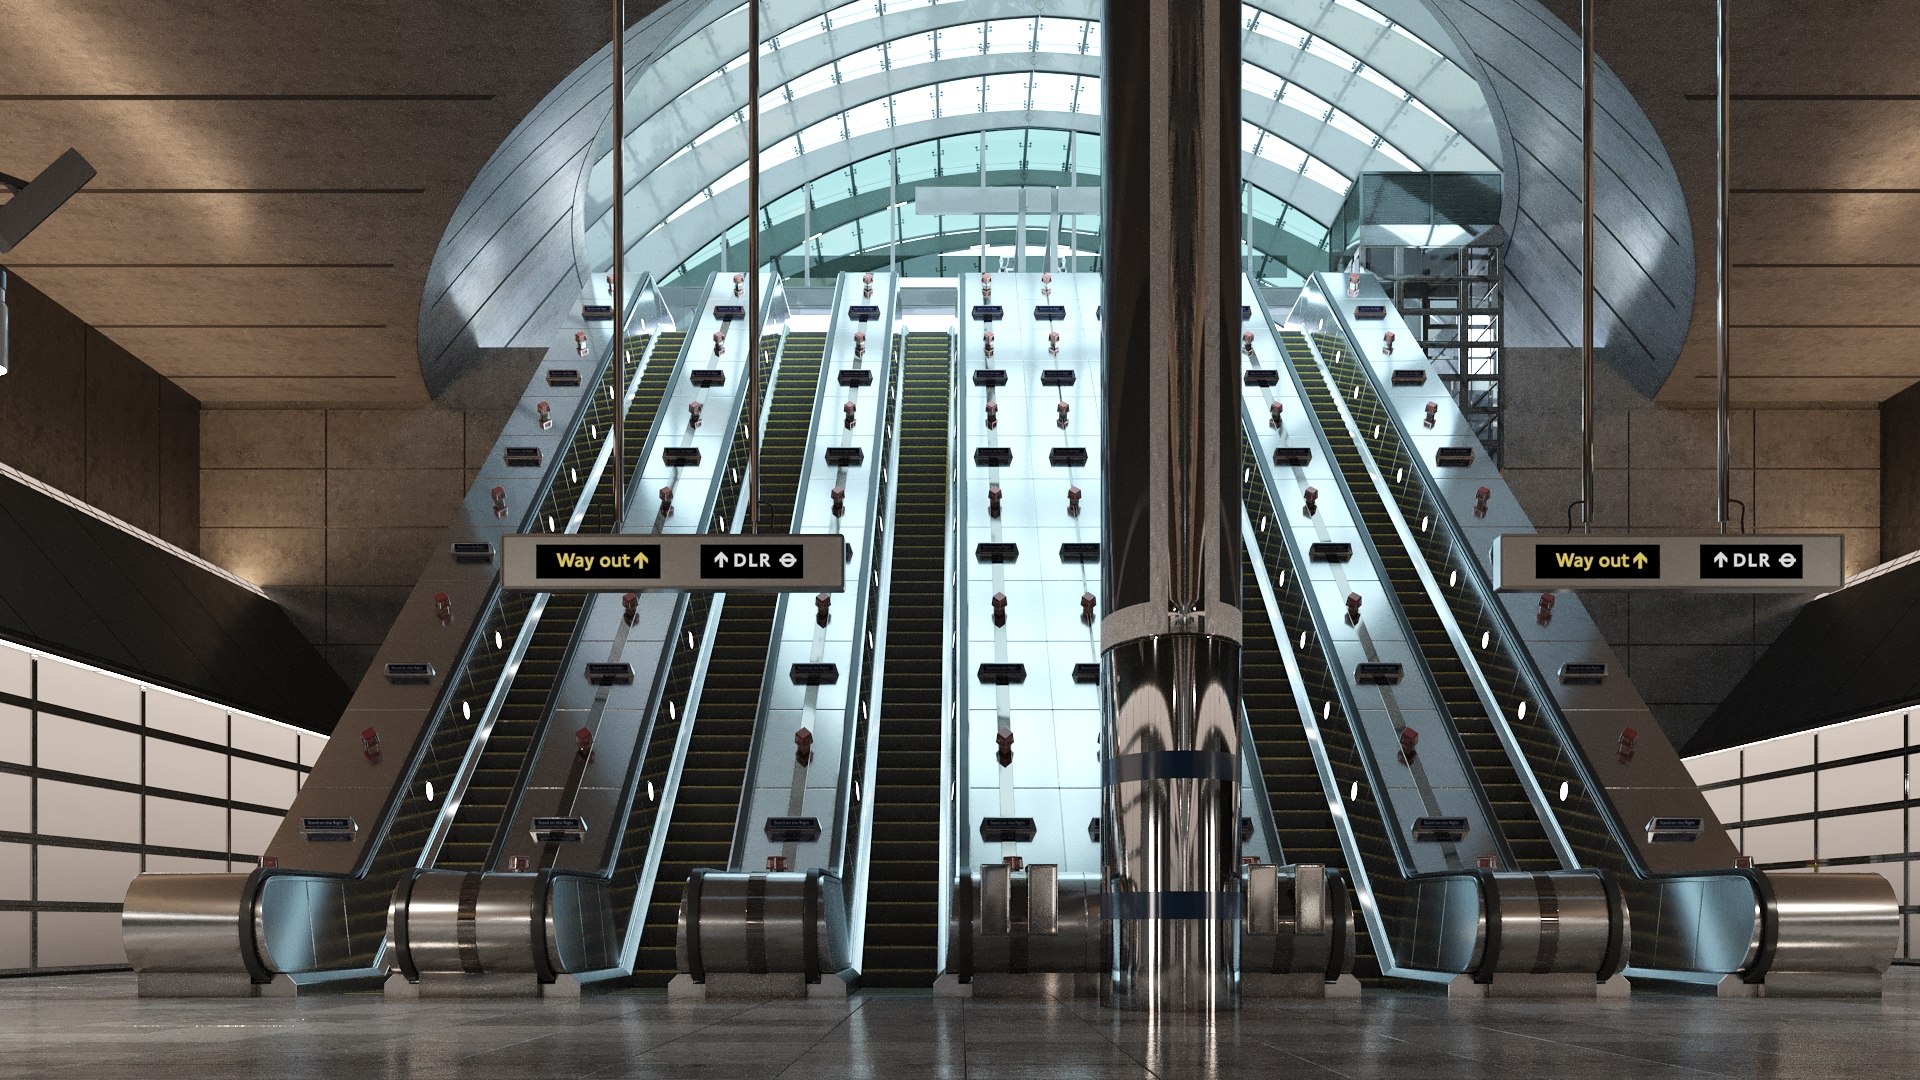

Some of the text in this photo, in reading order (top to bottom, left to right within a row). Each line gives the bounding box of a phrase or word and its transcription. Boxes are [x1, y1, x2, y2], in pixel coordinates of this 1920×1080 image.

[556, 552, 631, 571] Way out
[733, 552, 771, 567] DLR
[1555, 552, 1630, 571] Way out
[1733, 552, 1771, 567] DLR
